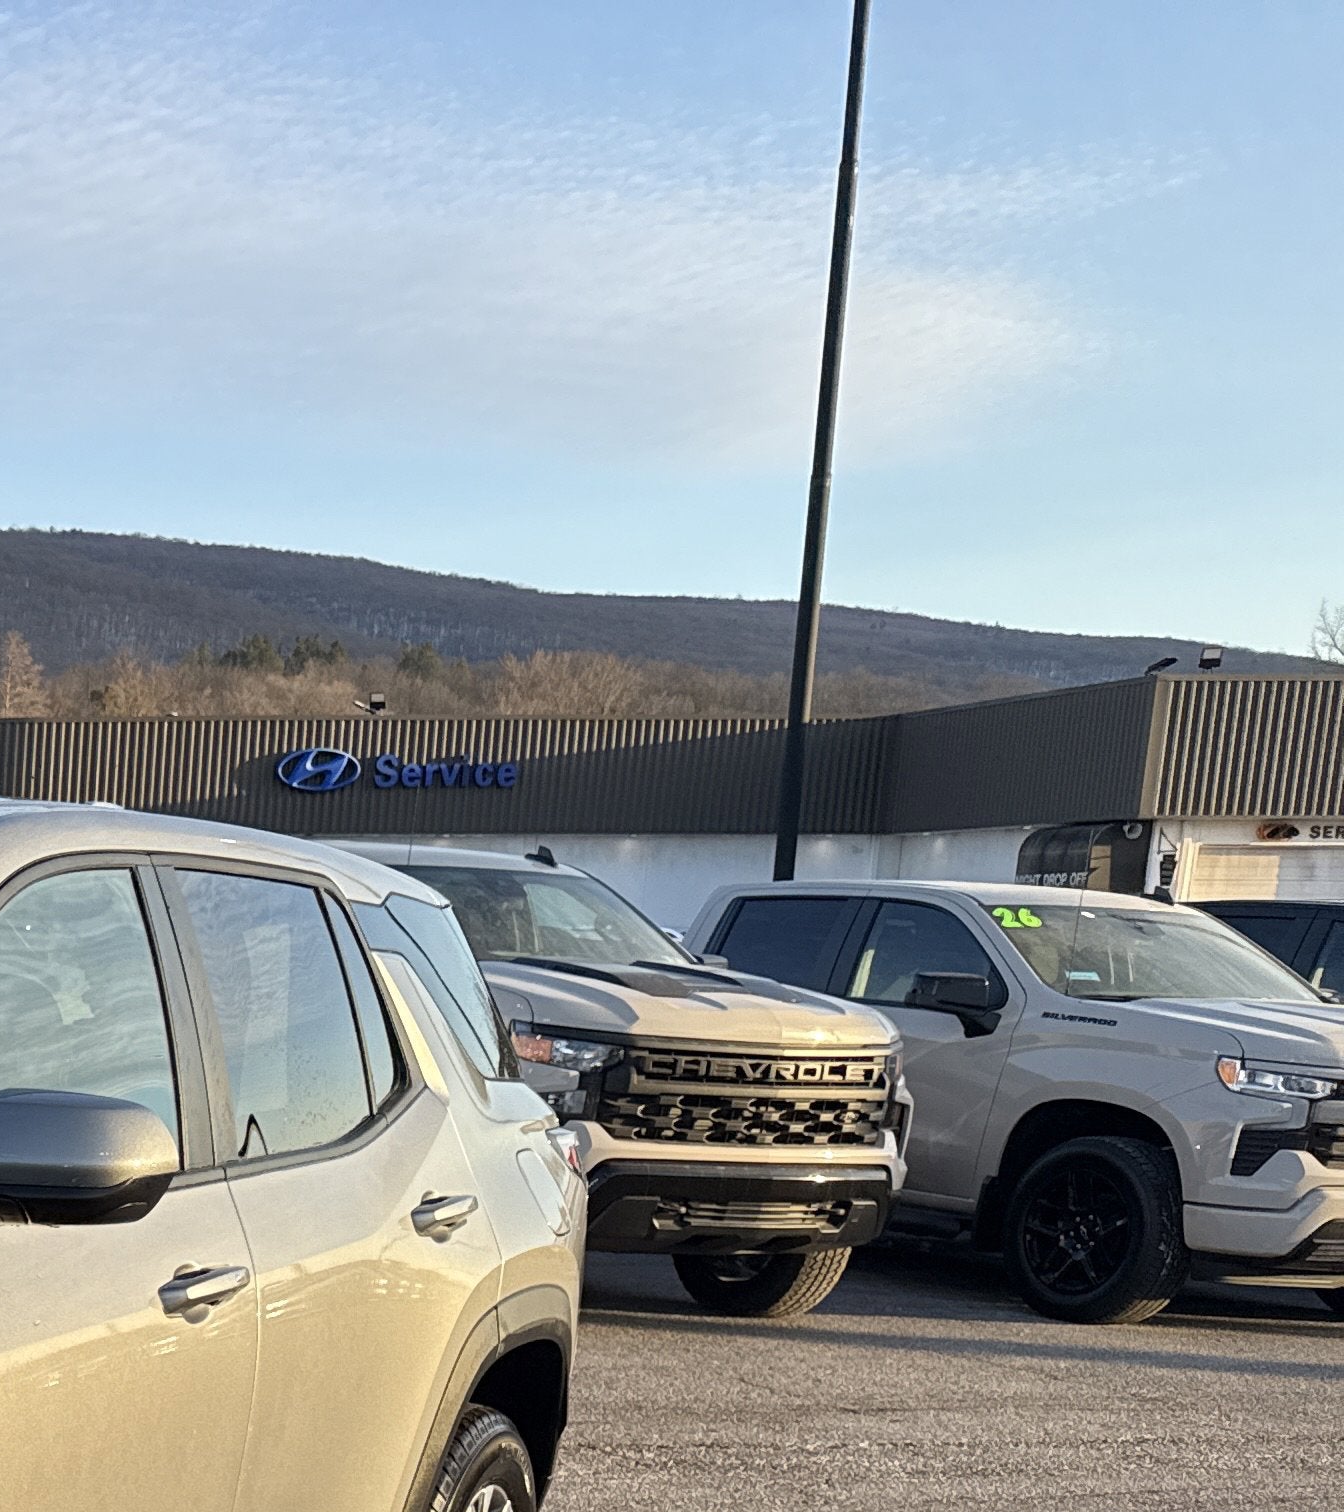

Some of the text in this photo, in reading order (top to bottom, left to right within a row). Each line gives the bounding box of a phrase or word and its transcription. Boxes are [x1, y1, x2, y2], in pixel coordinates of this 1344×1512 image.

[374, 754, 517, 788] Service
[1069, 871, 1088, 886] OFF
[992, 907, 1042, 928] 26
[1041, 1011, 1118, 1027] SILVERADO
[644, 1053, 886, 1087] CHEVROLET
